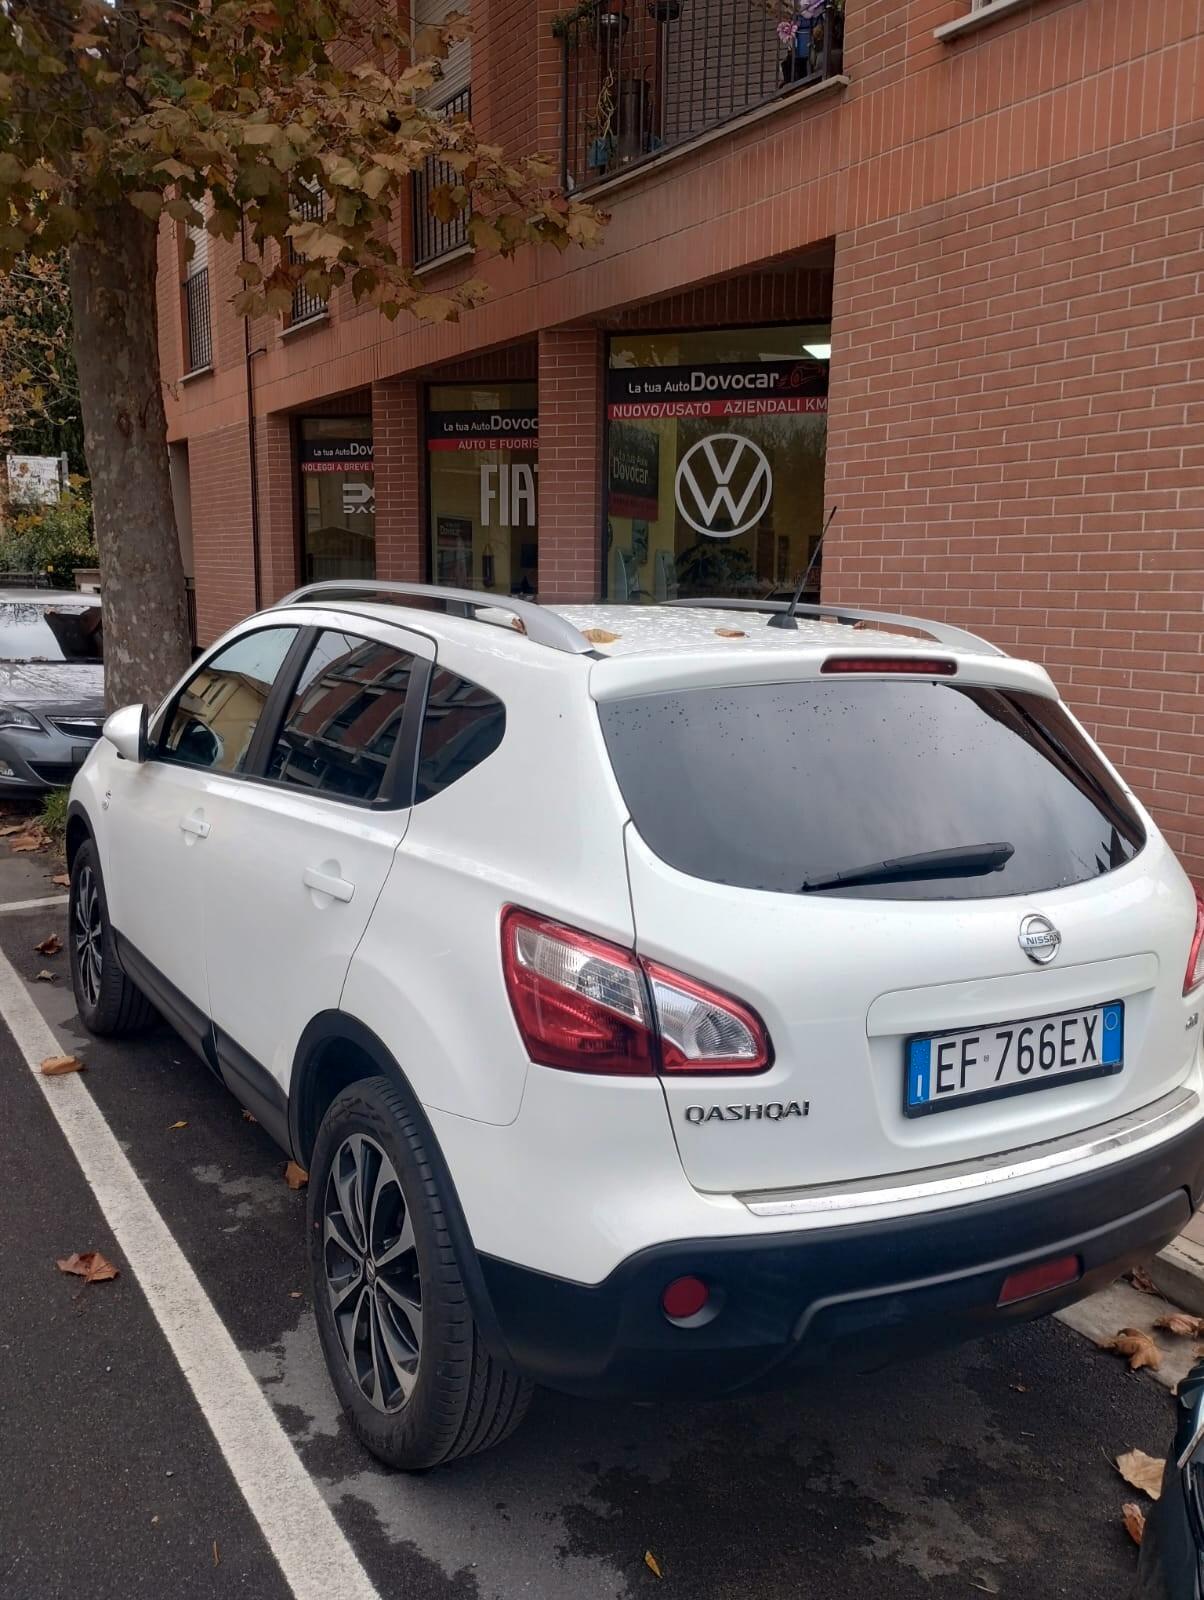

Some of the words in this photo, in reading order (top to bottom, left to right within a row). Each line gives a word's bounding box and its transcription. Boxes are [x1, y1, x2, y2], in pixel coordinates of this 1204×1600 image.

[628, 383, 641, 394] La
[644, 383, 662, 394] tua
[664, 381, 690, 393] Auto
[690, 371, 780, 392] Dovocar
[613, 402, 711, 418] NUOVO/USATO
[723, 399, 801, 415] AZIENDALI
[805, 398, 828, 412] KM
[443, 423, 454, 432] La
[455, 422, 470, 431] tua
[471, 421, 491, 431] Auto
[313, 448, 322, 456] La
[322, 448, 334, 456] tua
[458, 440, 486, 450] AUTO
[489, 439, 497, 449] E
[301, 463, 335, 472] NOLEGGI
[336, 463, 342, 471] A
[344, 463, 369, 471] BREVE
[480, 463, 539, 527] FIA
[1026, 934, 1060, 945] NISSAN
[935, 1036, 980, 1094] EF
[993, 1013, 1099, 1082] 766EX
[685, 1099, 810, 1126] QASHQAI
